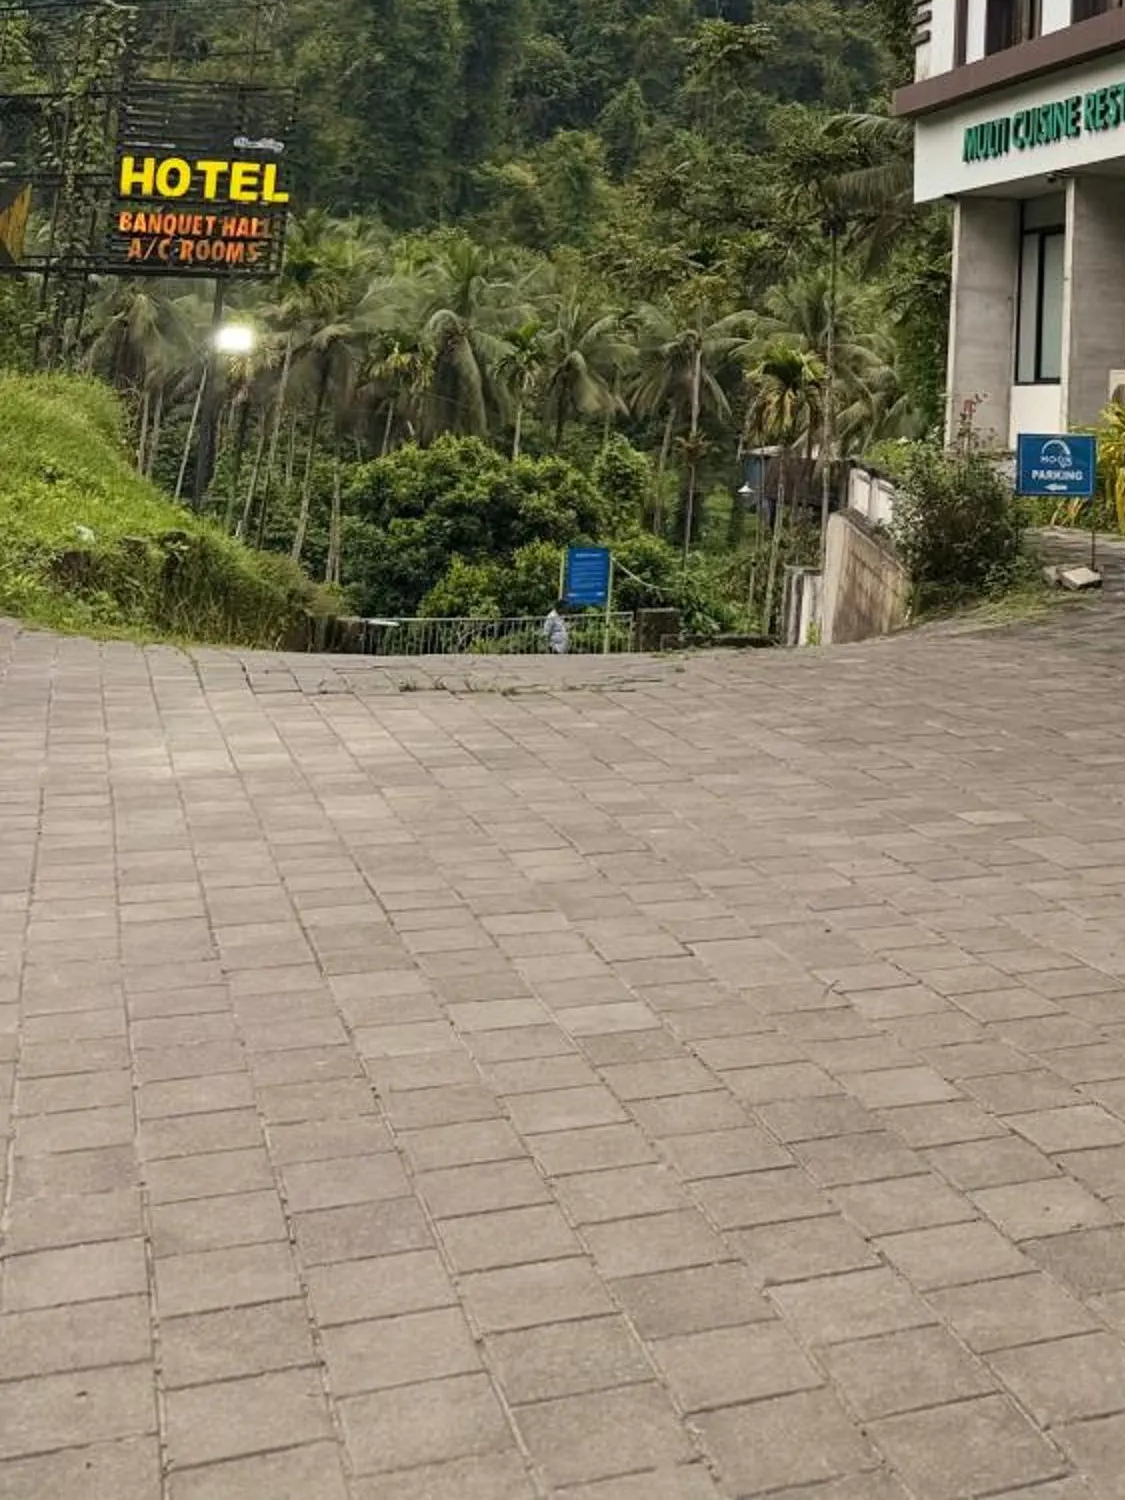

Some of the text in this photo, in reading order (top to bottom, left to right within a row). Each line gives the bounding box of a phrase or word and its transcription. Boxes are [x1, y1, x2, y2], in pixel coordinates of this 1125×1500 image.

[963, 117, 1010, 163] MULTI
[1012, 95, 1080, 149] CUISINE
[120, 155, 289, 203] HOTEL
[119, 211, 216, 236] BANQUET
[127, 237, 259, 264] A/C ROOMS
[1031, 469, 1083, 481] PARKING
